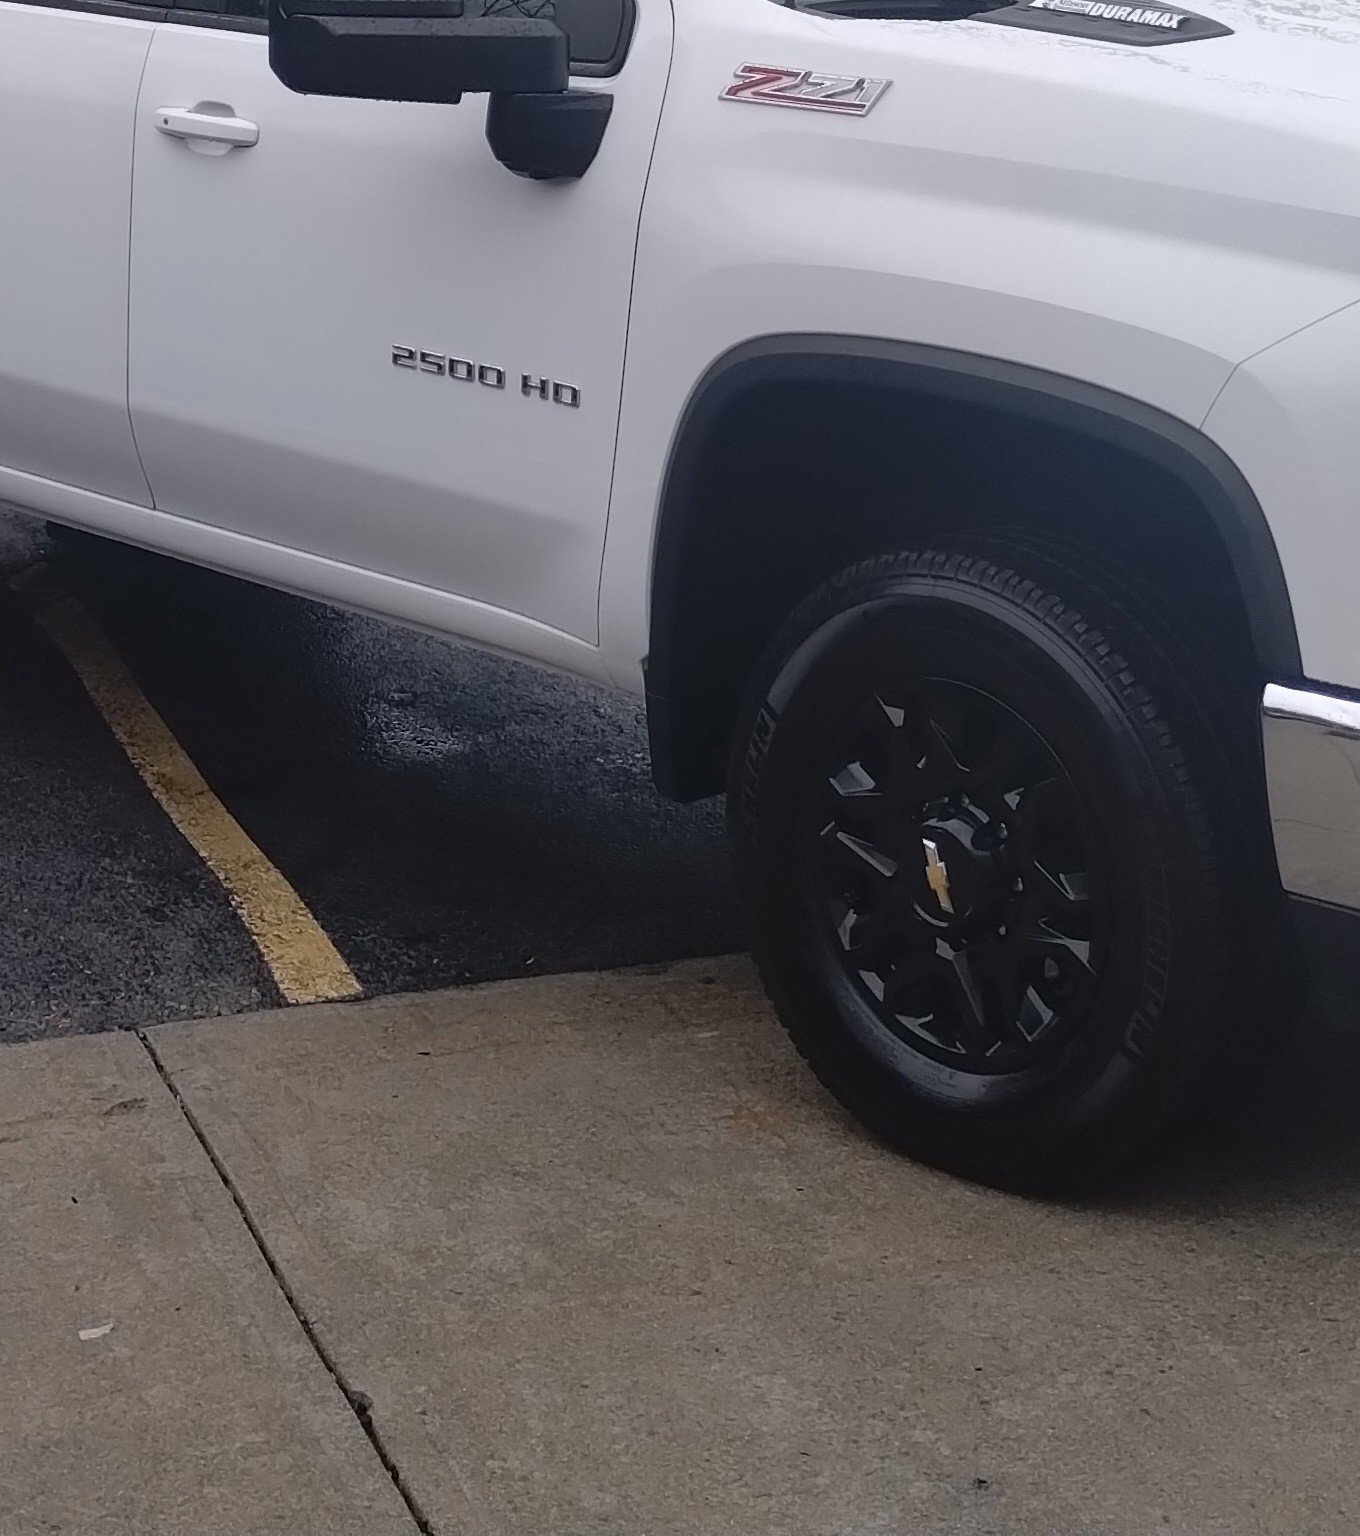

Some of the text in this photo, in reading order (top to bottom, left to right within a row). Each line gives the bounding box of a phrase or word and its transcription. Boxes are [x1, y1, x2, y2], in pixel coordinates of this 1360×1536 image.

[1089, 1, 1187, 30] DURAMAX
[718, 61, 894, 117] Z71
[391, 342, 582, 409] 2500 HD
